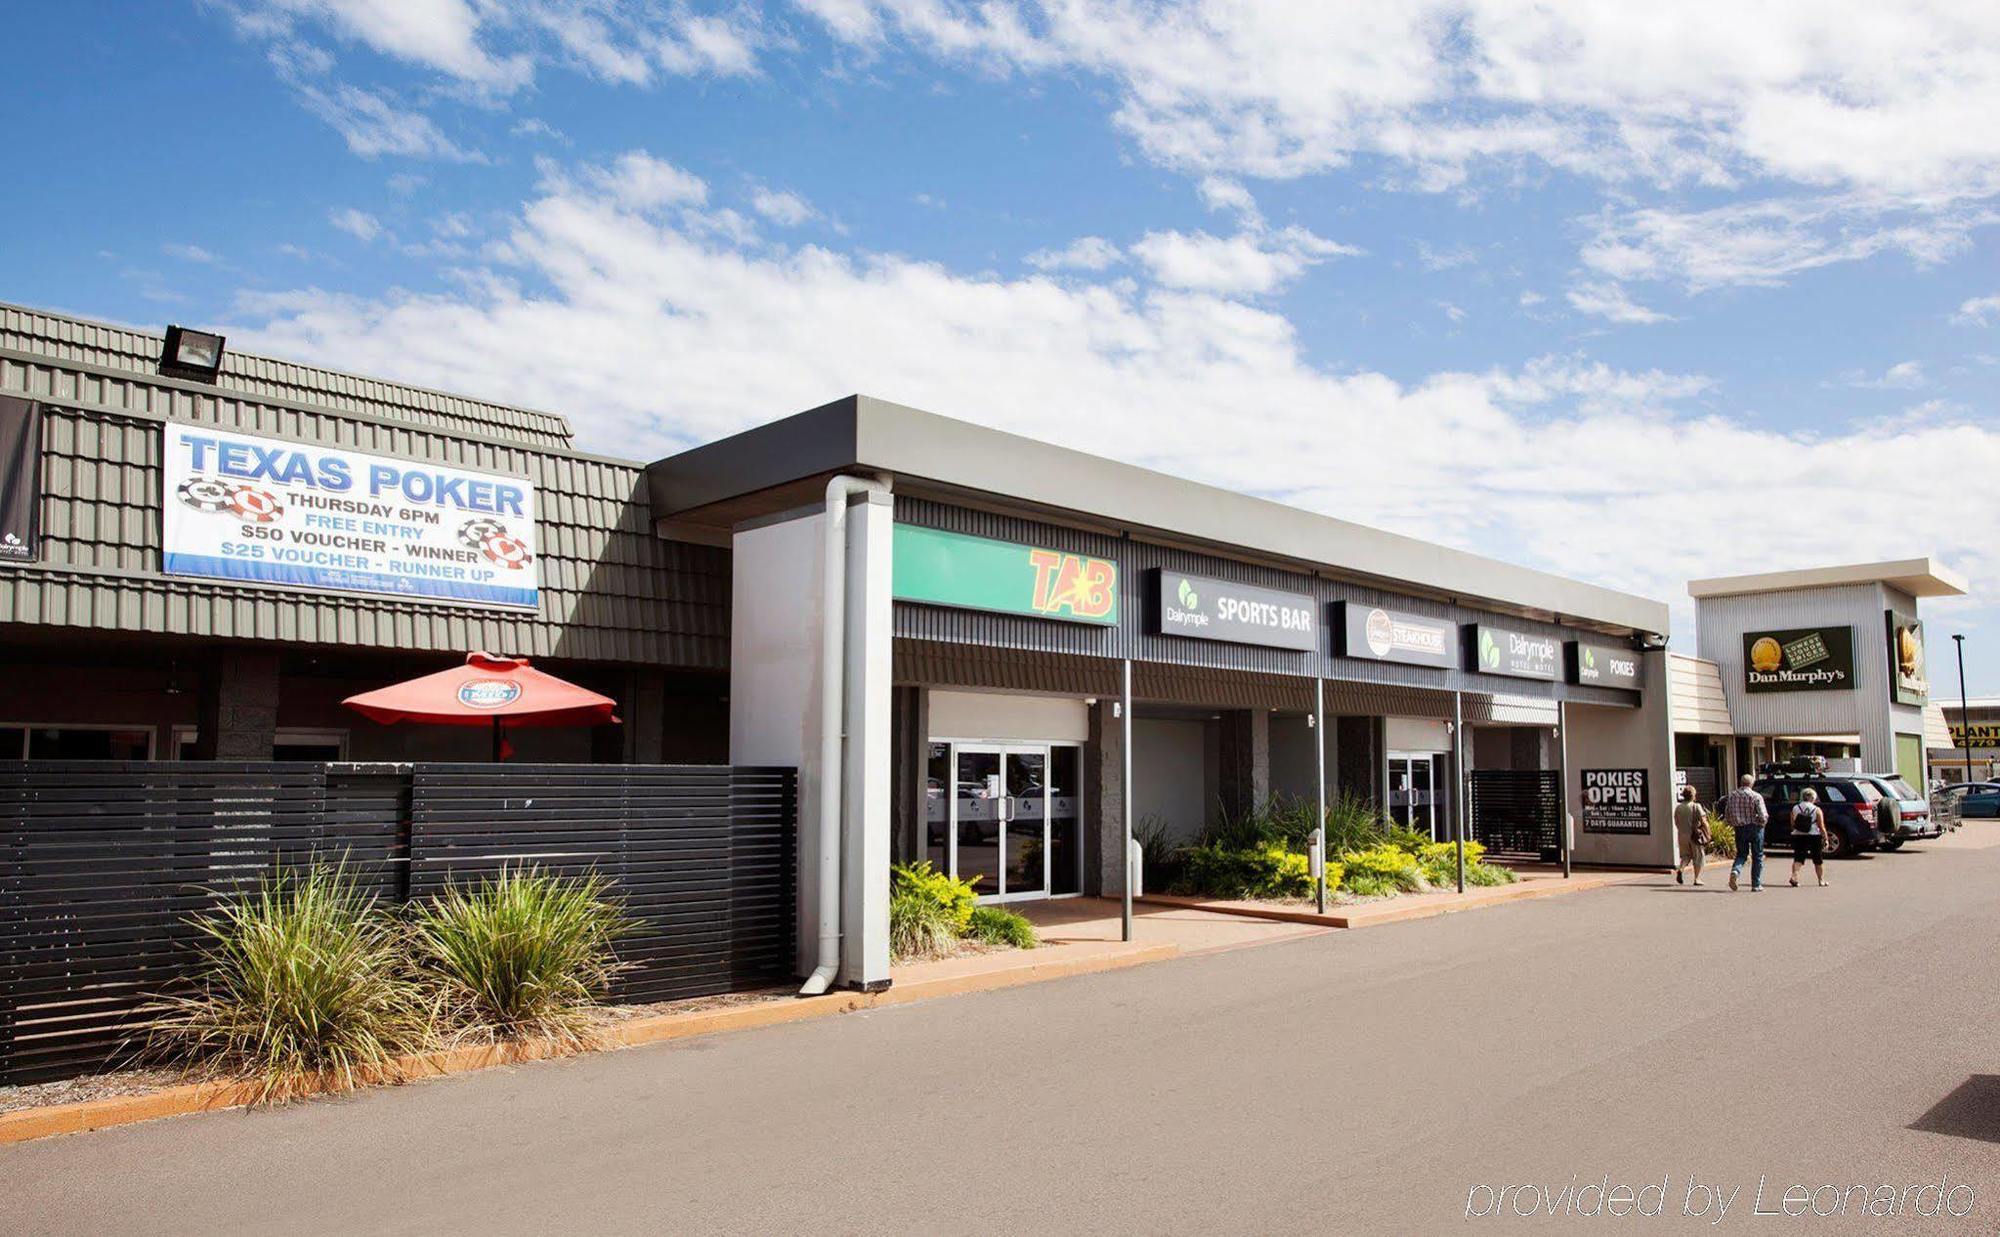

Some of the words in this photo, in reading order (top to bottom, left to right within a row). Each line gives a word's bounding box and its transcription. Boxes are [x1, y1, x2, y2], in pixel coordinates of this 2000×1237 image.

[180, 434, 352, 491] TEXAS
[369, 464, 524, 517] POKER
[287, 493, 393, 518] THURSDAY
[400, 508, 440, 525] 6PM
[305, 514, 357, 531] FREE
[363, 521, 424, 540] ENTRY
[241, 524, 284, 542] $50
[290, 530, 386, 553] VOUCHER
[405, 544, 478, 564] WINNER
[221, 541, 265, 558] $25
[271, 547, 369, 570] VOUCHER
[389, 560, 465, 580] RUNNER
[471, 569, 495, 582] UP
[1029, 548, 1115, 618] TAB
[1166, 607, 1209, 628] Dalrymple
[1217, 597, 1279, 627] SPORTS
[1281, 607, 1311, 632] BAR
[1509, 633, 1554, 663] Dalrymple
[1785, 637, 1819, 652] LOWEST
[1609, 659, 1635, 677] POKIES
[1749, 671, 1778, 683] Dan
[1778, 669, 1845, 684] Murphy's
[1586, 771, 1642, 787] POKIES
[1588, 786, 1642, 804] OPEN
